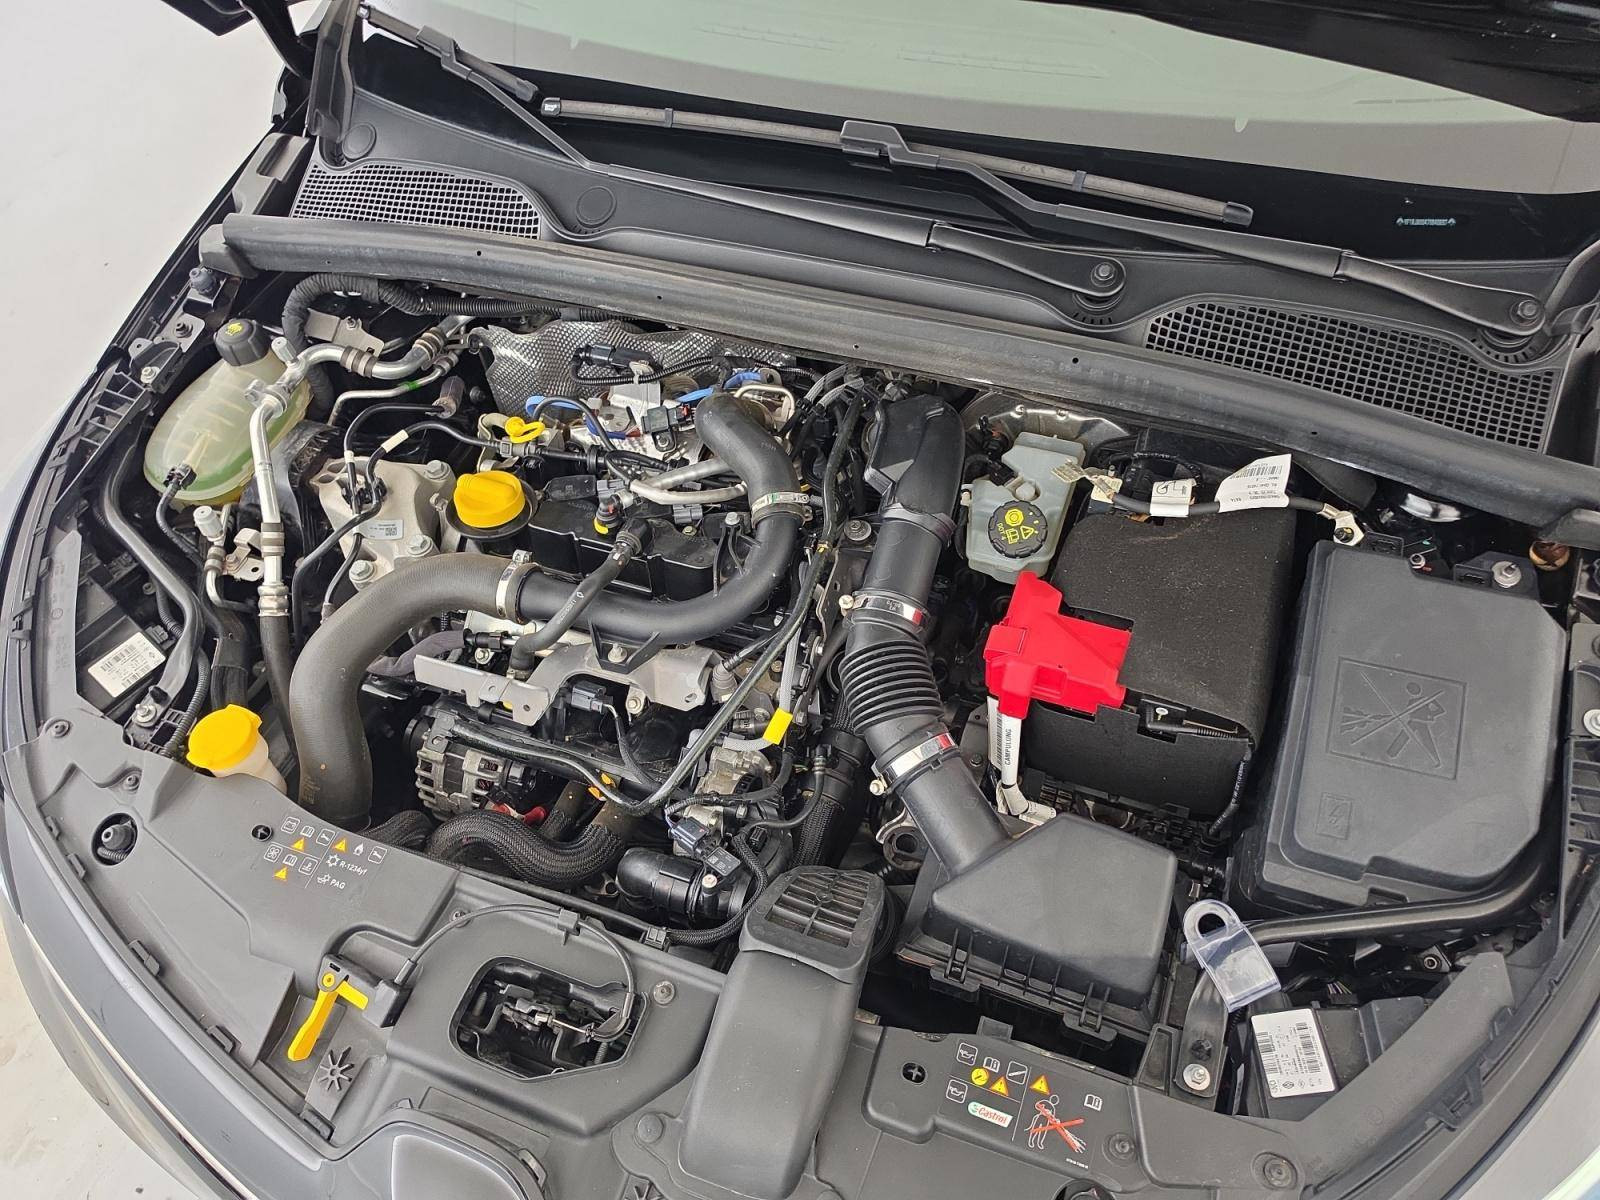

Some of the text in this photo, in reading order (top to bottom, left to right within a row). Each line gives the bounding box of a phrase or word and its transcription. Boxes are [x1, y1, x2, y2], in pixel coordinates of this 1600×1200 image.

[997, 522, 1006, 535] DOT
[330, 879, 346, 889] PAG
[978, 1107, 1008, 1124] Castrol
